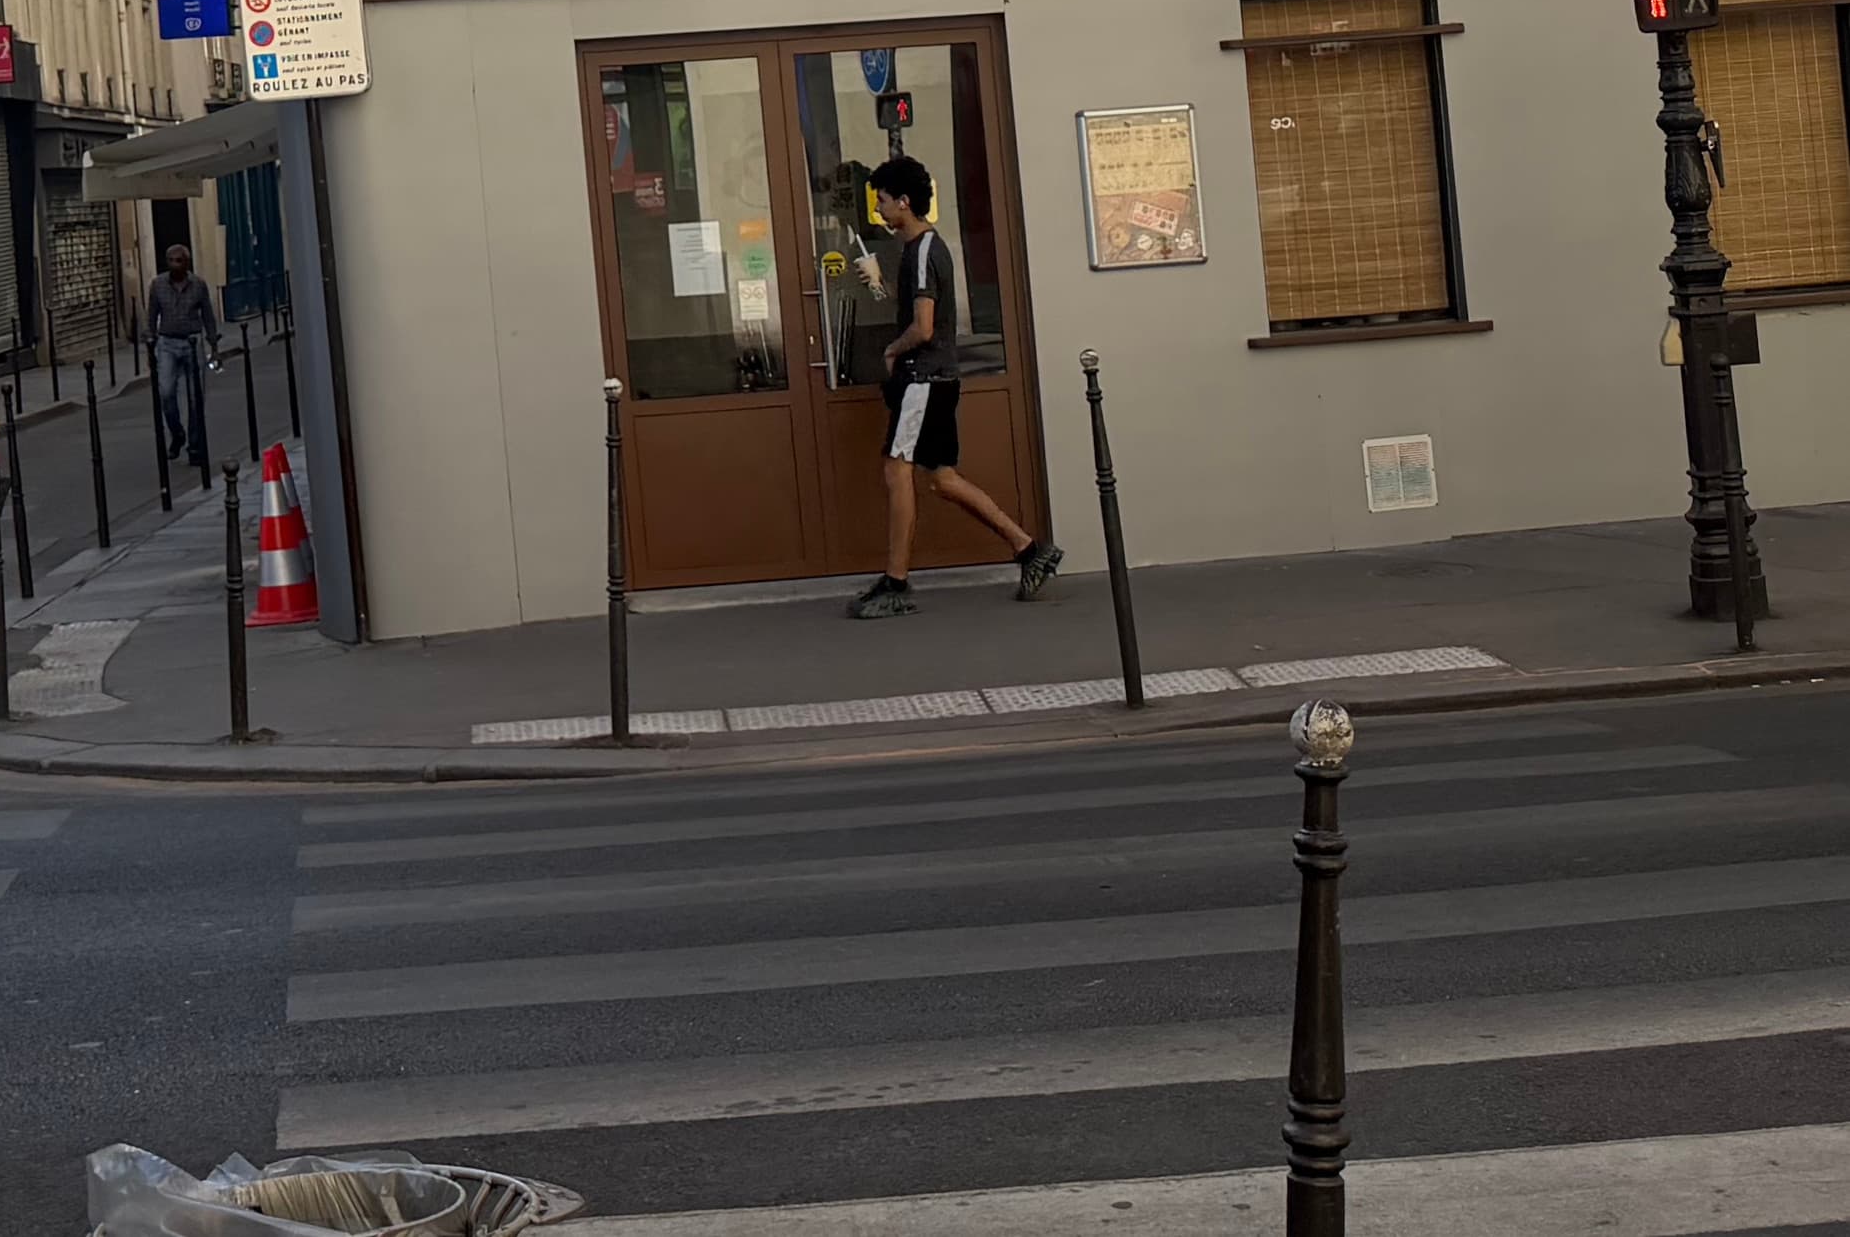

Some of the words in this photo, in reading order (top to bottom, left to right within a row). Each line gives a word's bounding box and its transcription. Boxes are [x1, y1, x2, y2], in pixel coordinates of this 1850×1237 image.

[276, 11, 343, 25] STATIONNEMENT
[281, 53, 299, 63] VOIE
[302, 51, 313, 61] EN
[314, 49, 351, 60] IMPASSE
[252, 78, 309, 93] ROULEZ
[315, 76, 333, 88] AU
[339, 73, 366, 86] PAS
